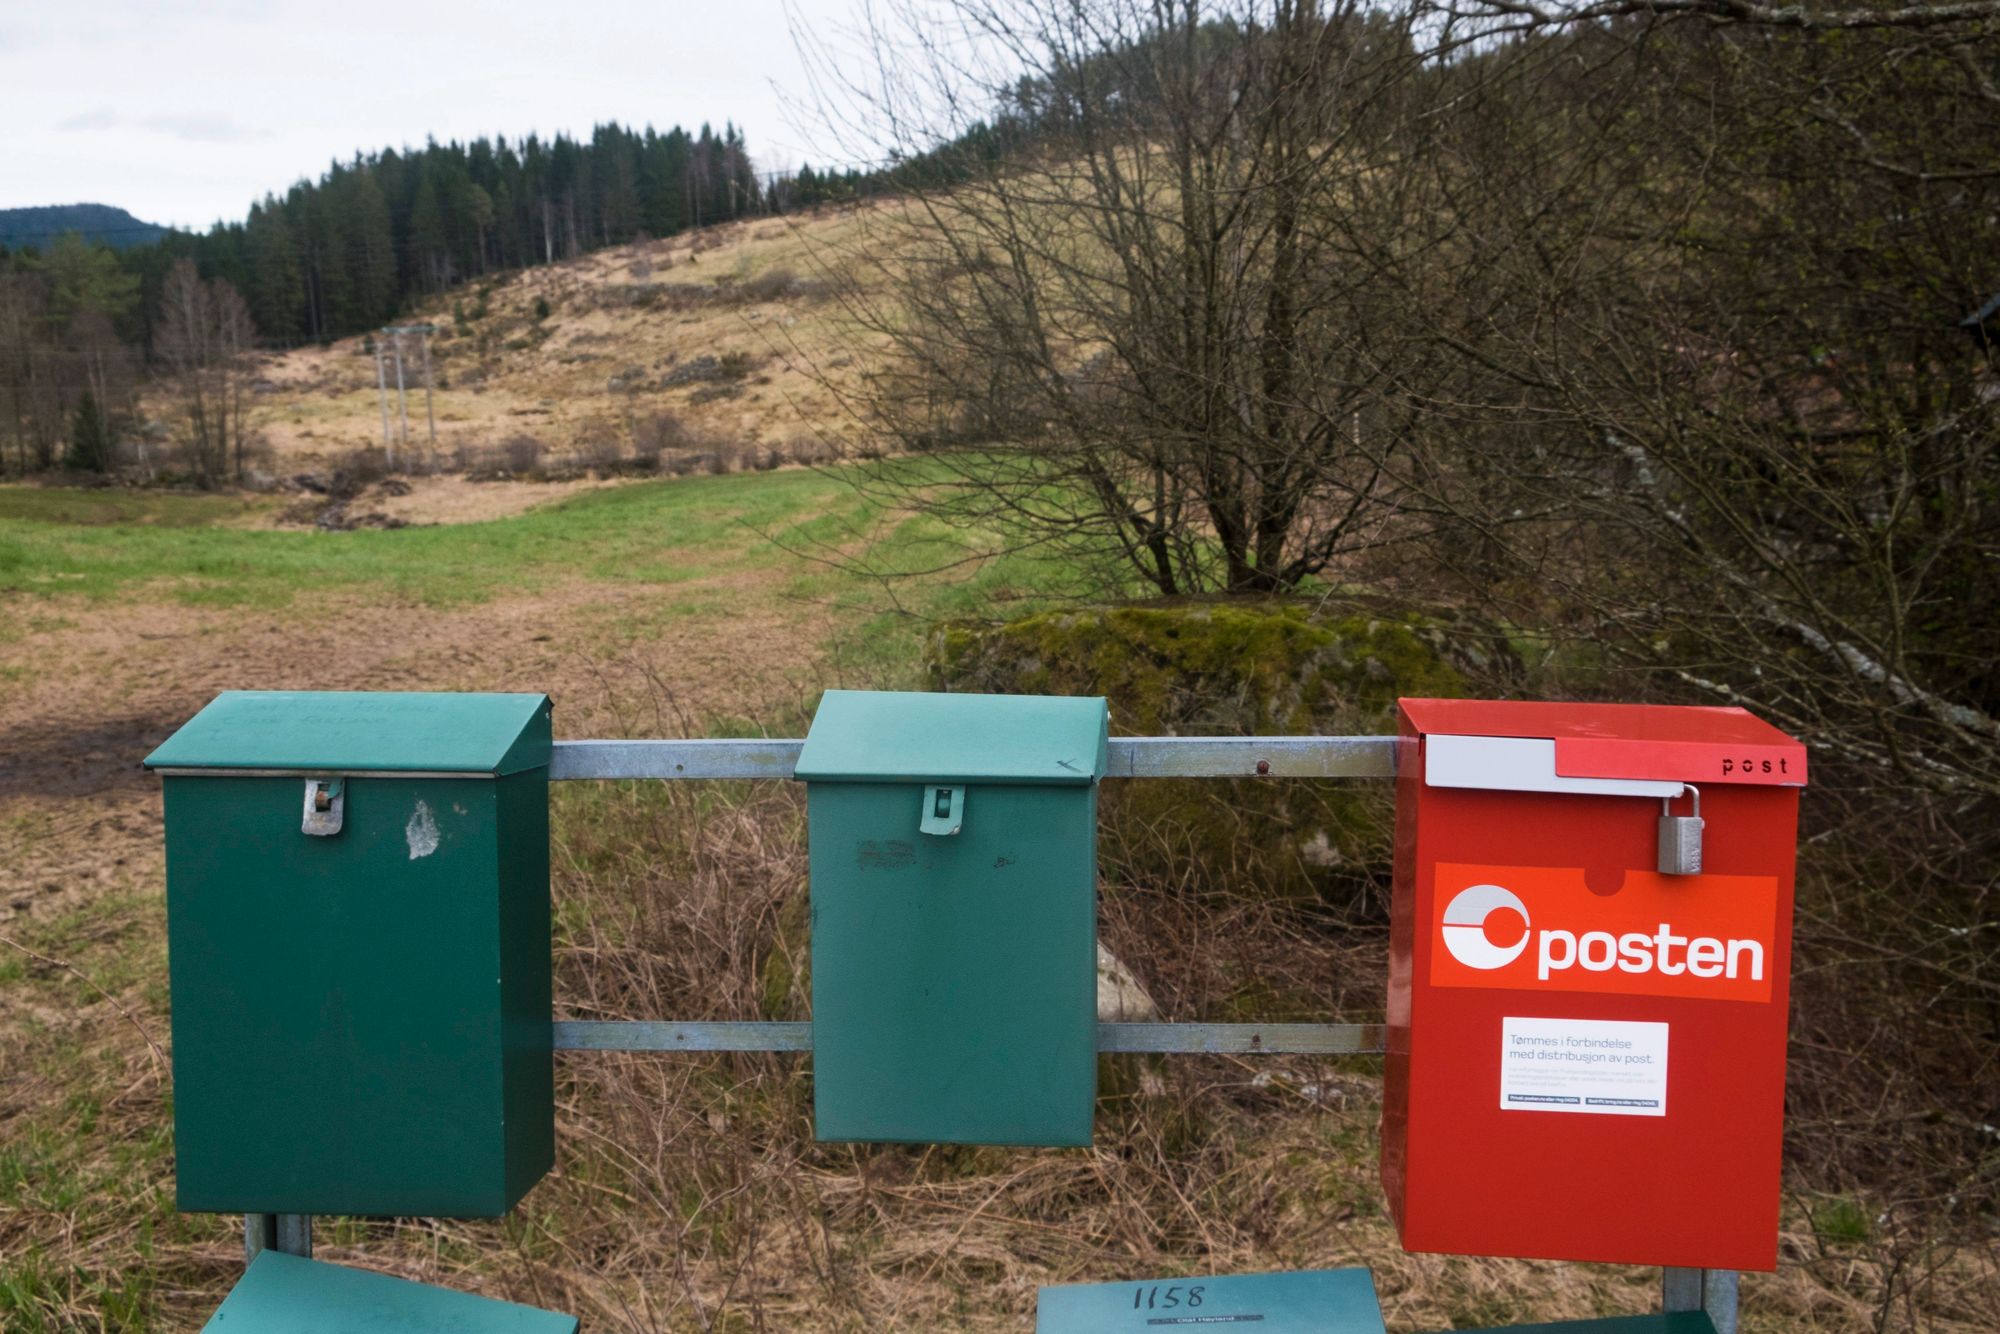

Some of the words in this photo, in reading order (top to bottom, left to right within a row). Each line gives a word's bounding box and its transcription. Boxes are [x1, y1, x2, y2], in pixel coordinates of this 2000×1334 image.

[1722, 758, 1787, 775] post
[1538, 923, 1764, 981] posten
[1510, 1034, 1558, 1046] Tømmes
[1567, 1036, 1632, 1049] forbindelse
[1509, 1050, 1535, 1060] med
[1537, 1050, 1606, 1064] distribusjon
[1609, 1054, 1622, 1063] av
[1625, 1053, 1655, 1065] post.
[1134, 1286, 1206, 1310] 1158
